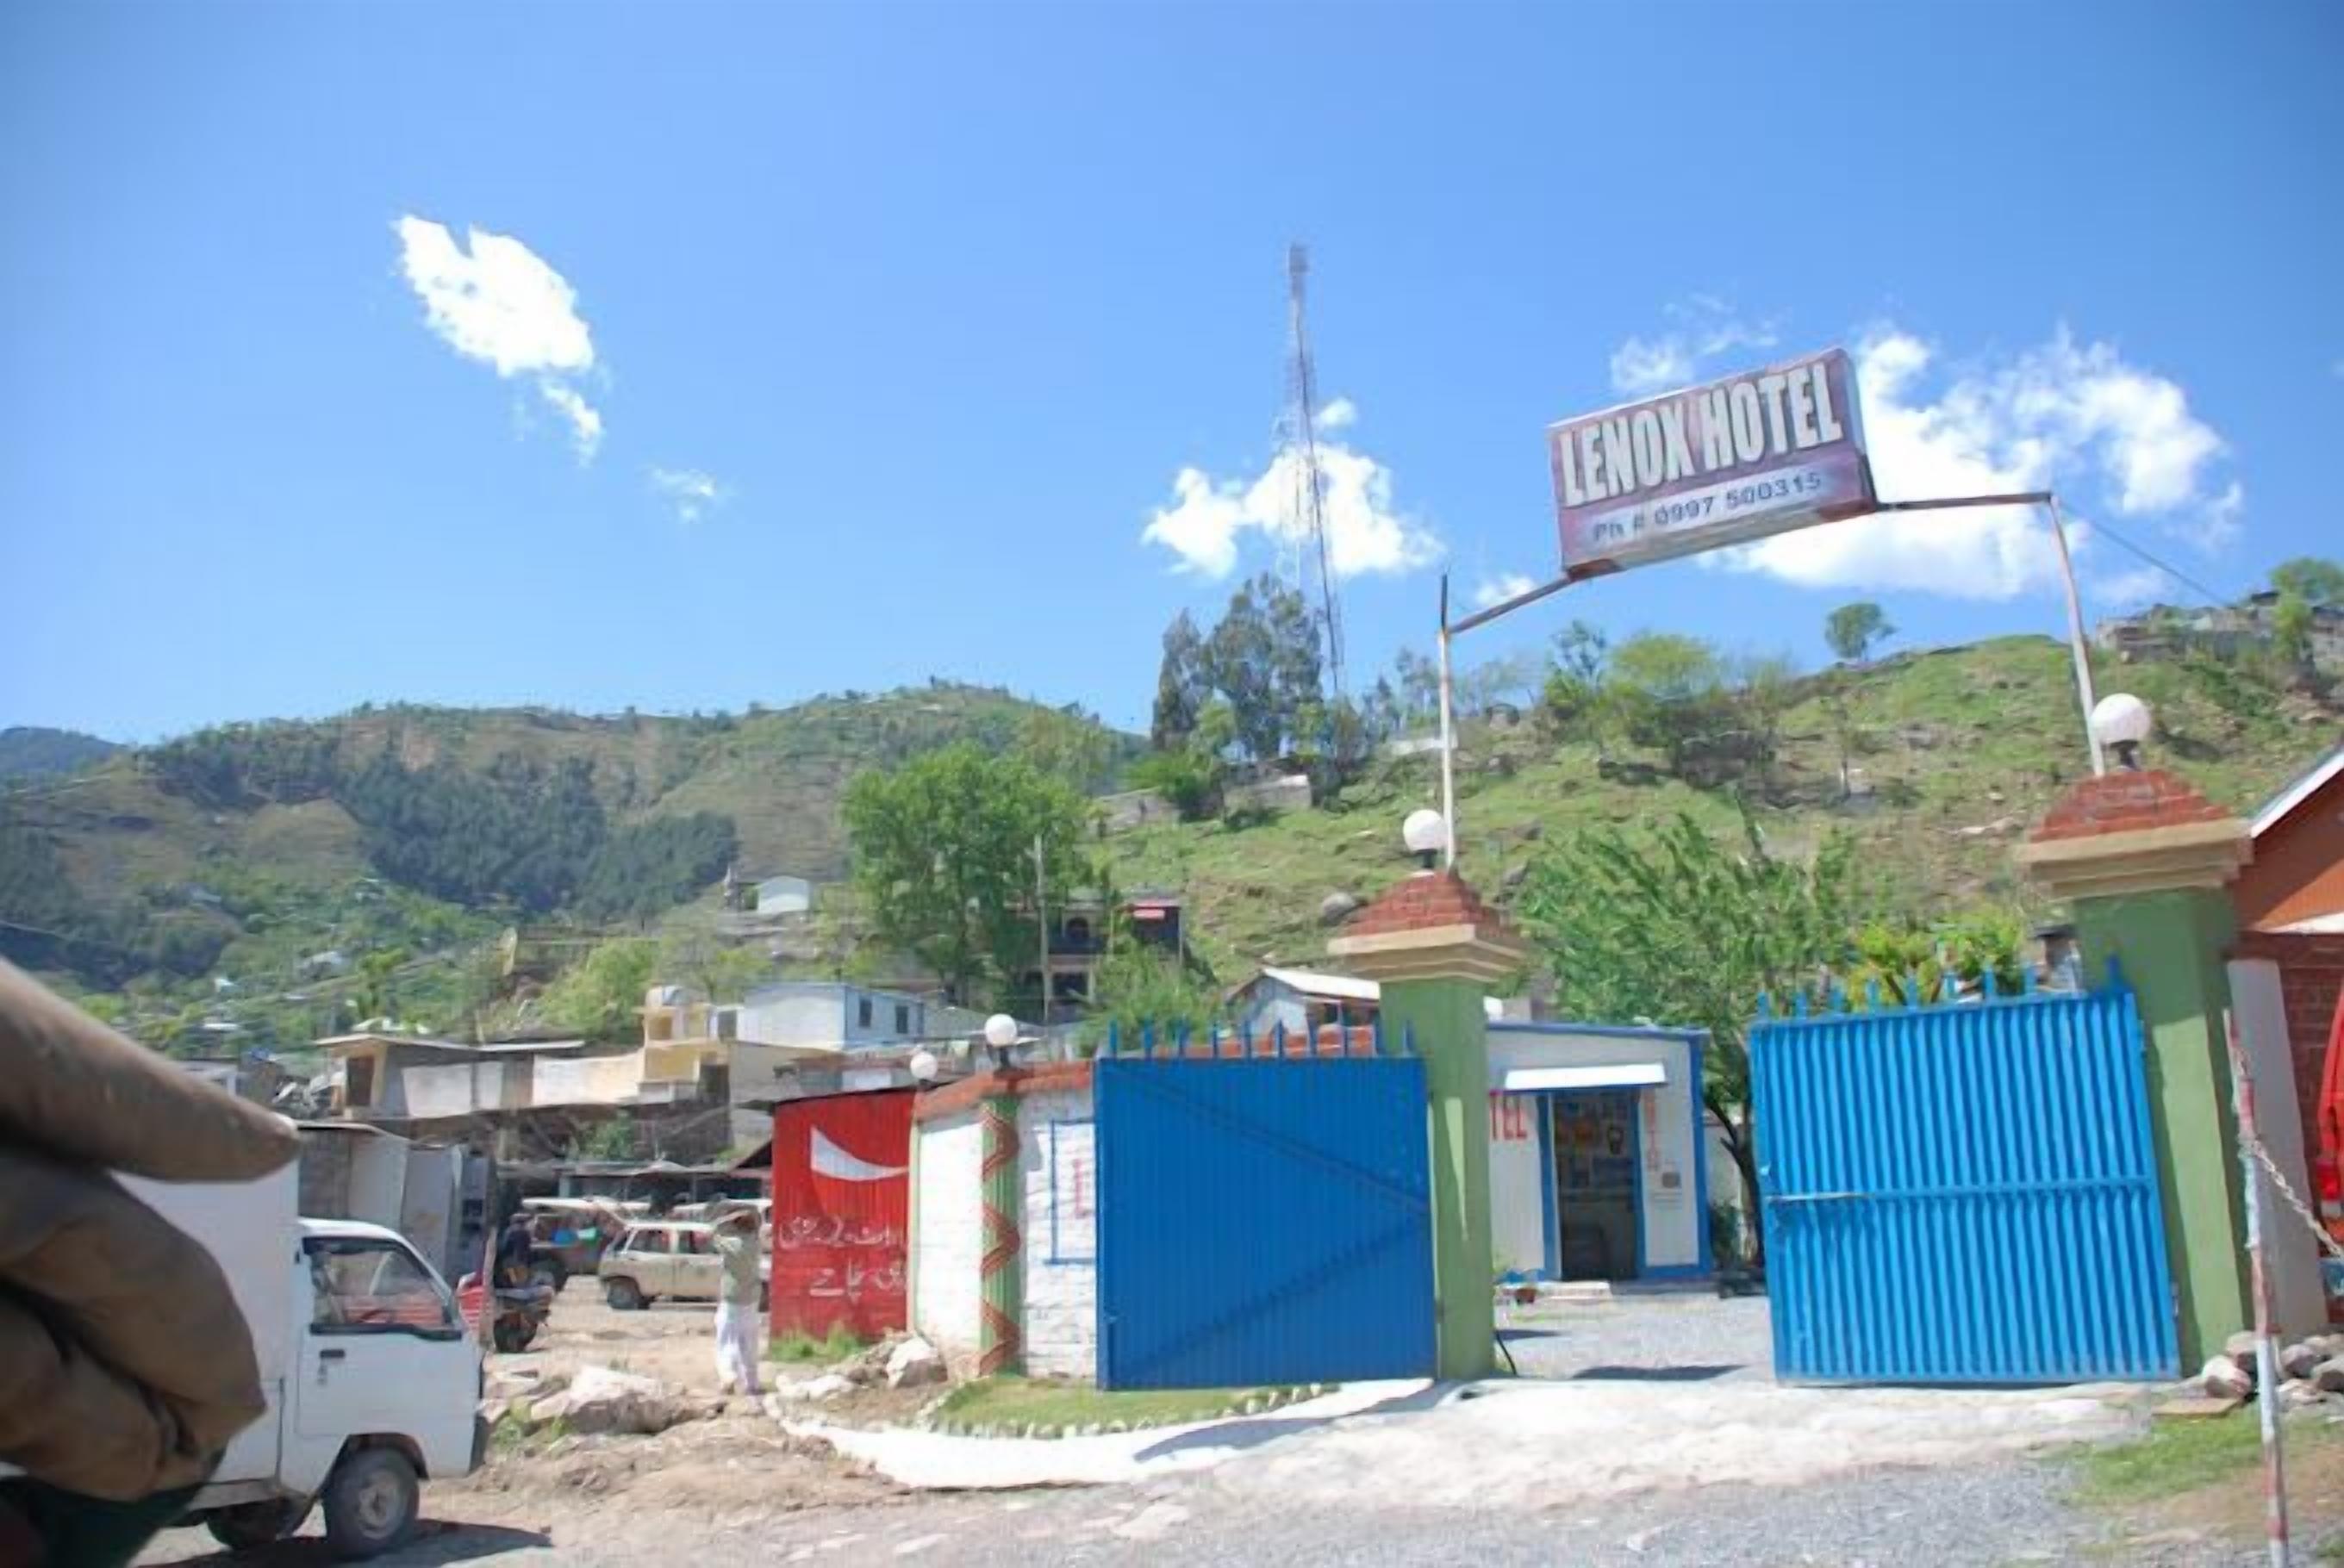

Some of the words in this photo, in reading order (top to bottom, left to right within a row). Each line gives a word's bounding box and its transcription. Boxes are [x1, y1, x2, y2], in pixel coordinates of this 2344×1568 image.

[1558, 401, 1695, 506] LENOX
[1699, 362, 1843, 468] HOTEL
[1655, 496, 1714, 526] 0997
[1726, 472, 1821, 510] 500315
